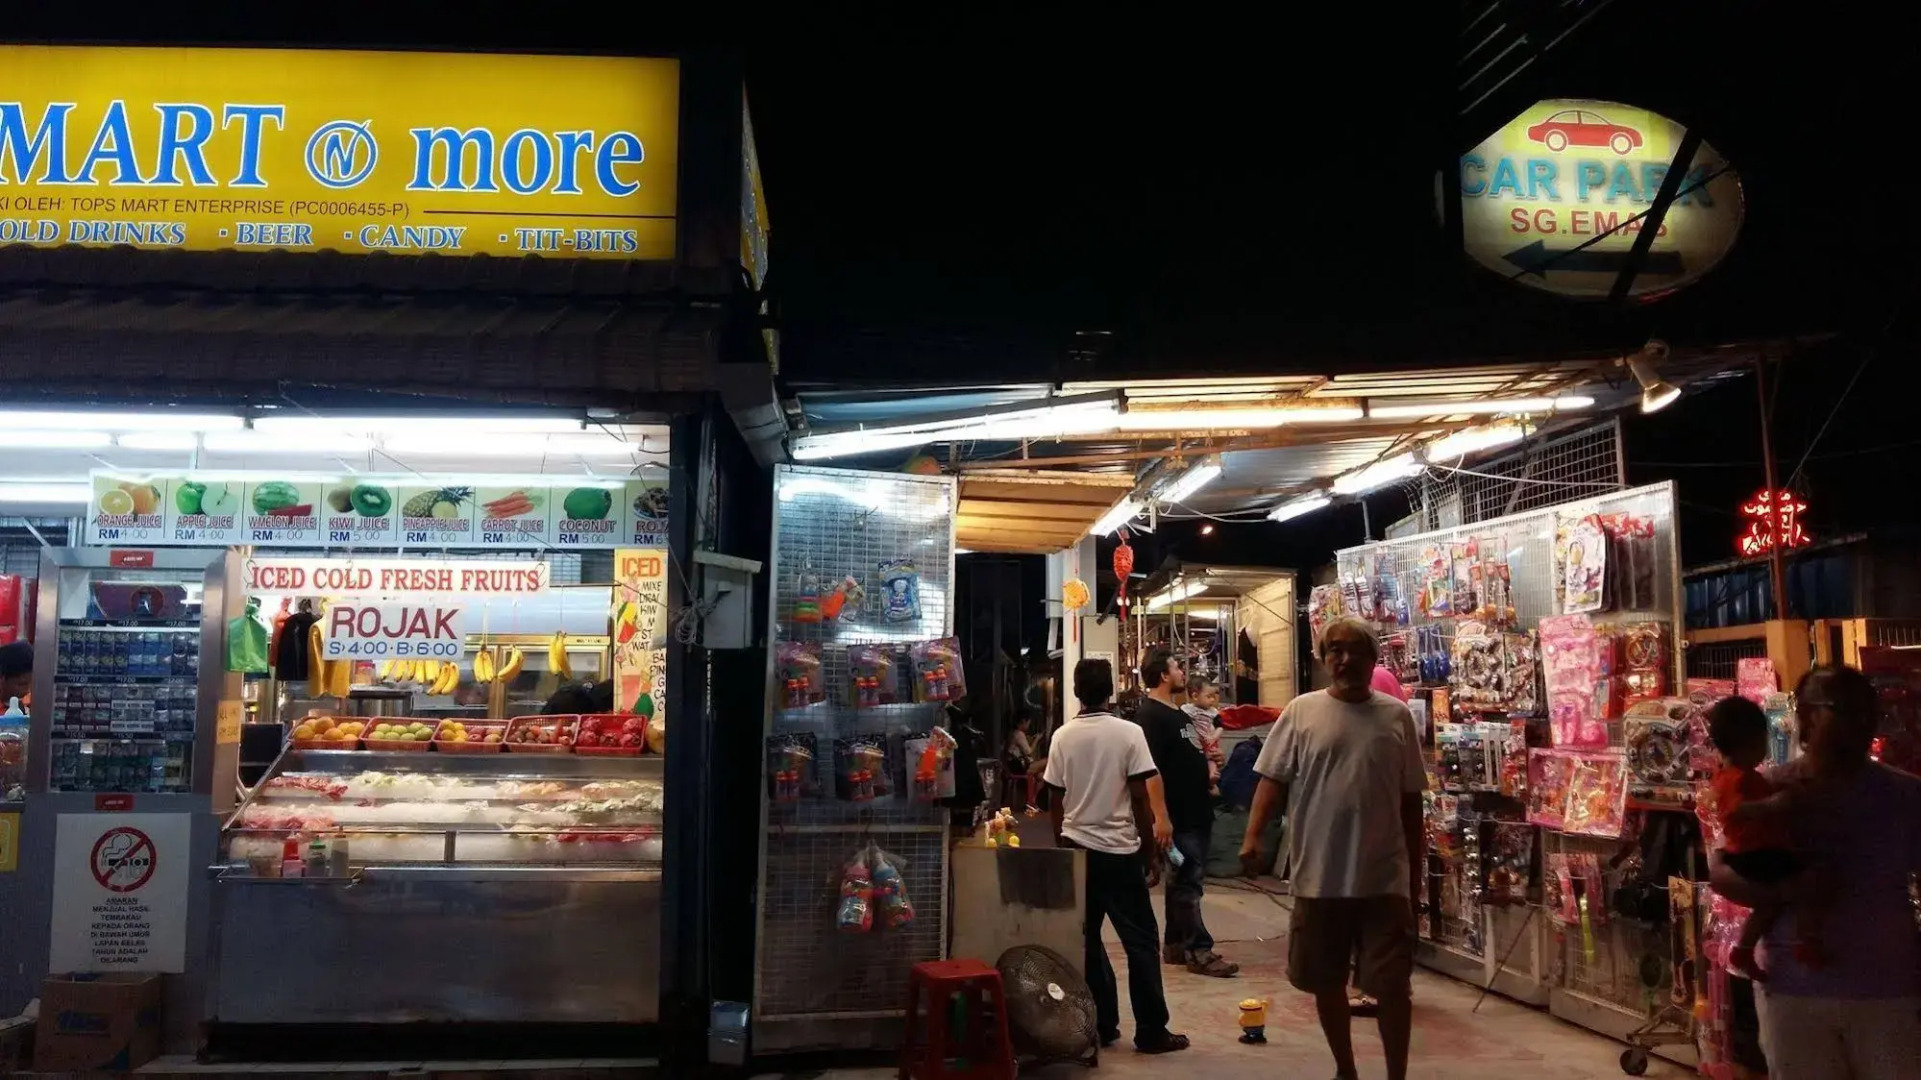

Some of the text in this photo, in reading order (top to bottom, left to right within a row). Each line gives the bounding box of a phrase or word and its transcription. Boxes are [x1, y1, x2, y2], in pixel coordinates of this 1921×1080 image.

[0, 100, 286, 187] MART
[406, 127, 645, 196] more
[1460, 154, 1561, 201] CAR
[14, 197, 65, 212] OLEH:
[71, 198, 116, 212] TOPS
[122, 199, 169, 213] MART
[174, 199, 284, 214] ENTERPRISE
[289, 201, 410, 220] (PC0006455-P)
[66, 220, 186, 246] DRINKS
[235, 222, 313, 247] BEER
[359, 225, 467, 249] CANDY
[515, 228, 637, 253] TIT-BITS
[98, 514, 162, 528] ORANGE JUICE
[176, 515, 234, 529] APPLE JUICE
[291, 516, 317, 529] JUICE
[329, 517, 390, 531] KIWI JUICE
[403, 518, 469, 532] PINEAPPLE JUICE
[481, 519, 543, 532] CARROT JUICE
[559, 520, 616, 533] COCONUT
[621, 557, 661, 577] ICED
[251, 566, 540, 591] ICED COLD FRESH FRUITS
[330, 606, 460, 640] ROJAK
